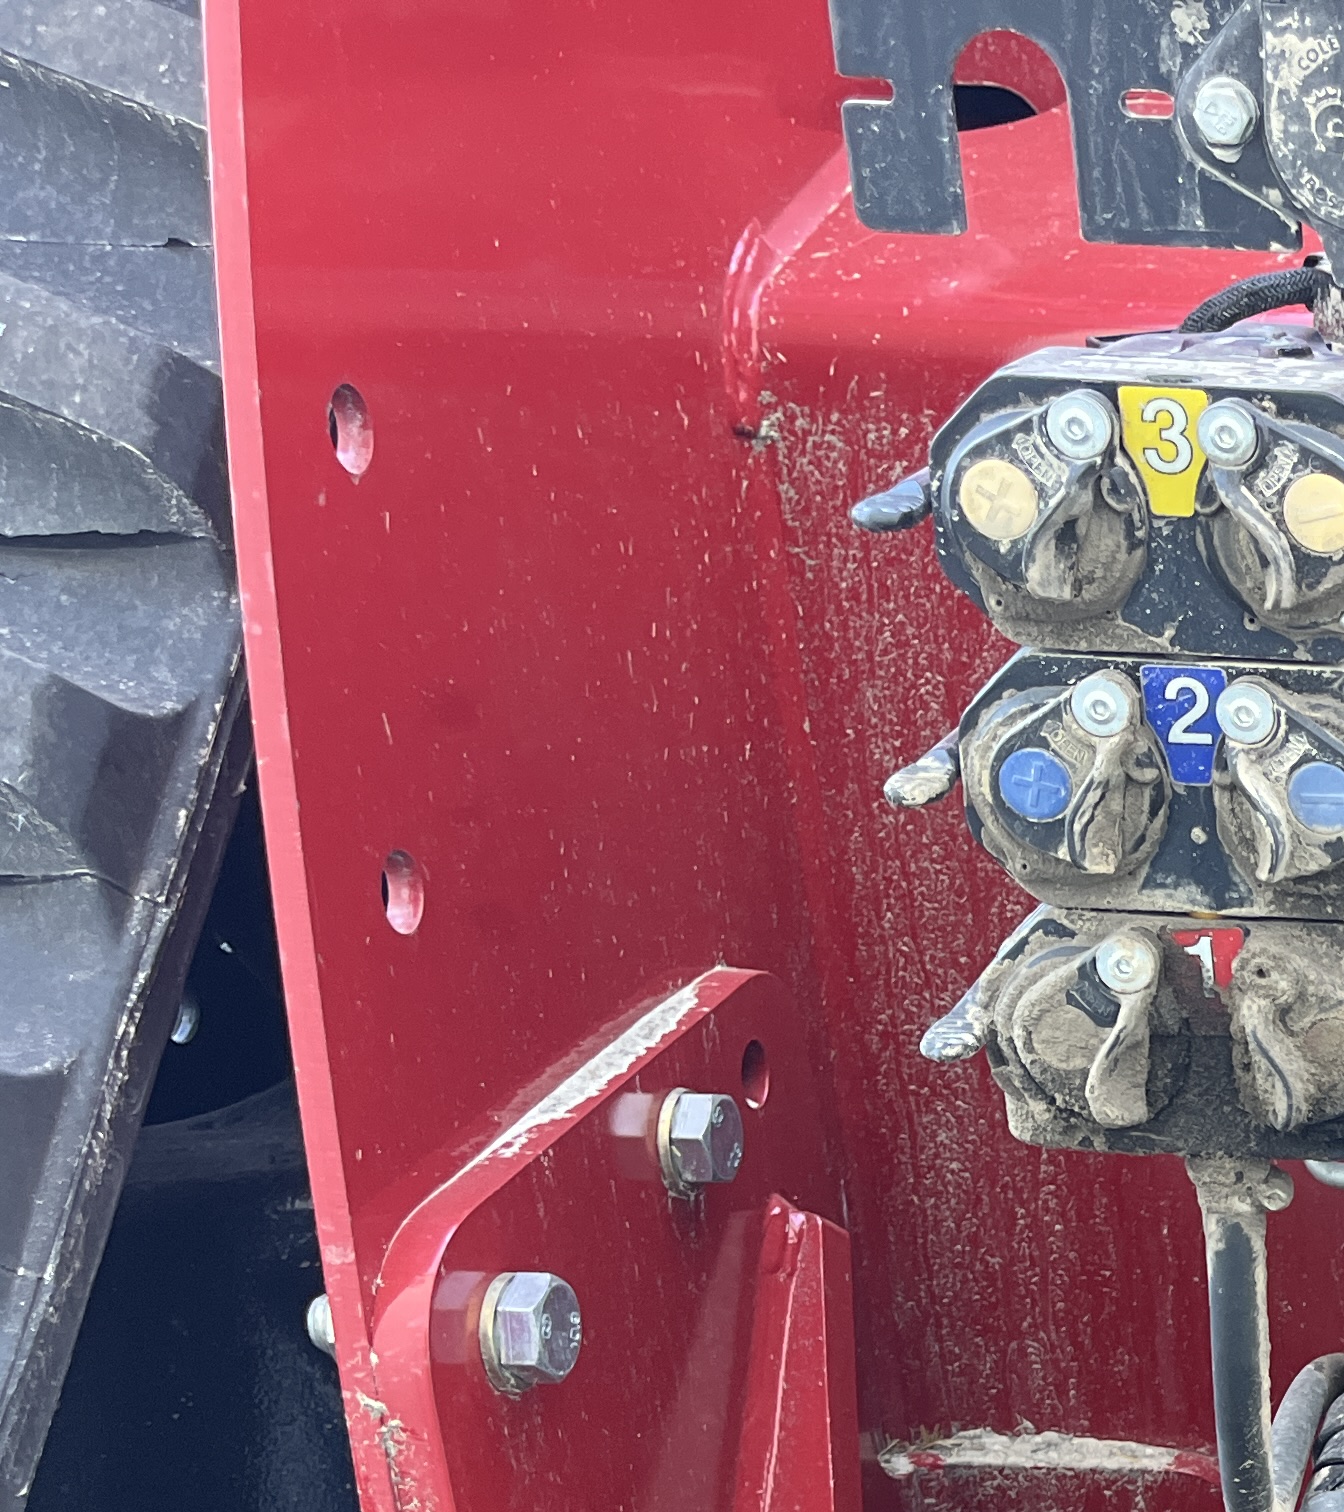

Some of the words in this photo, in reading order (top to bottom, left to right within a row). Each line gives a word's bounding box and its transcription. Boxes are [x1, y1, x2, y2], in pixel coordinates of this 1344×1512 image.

[1297, 35, 1340, 71] COLE
[1141, 397, 1193, 475] 3
[1261, 448, 1296, 494] OPEN
[1164, 677, 1213, 745] 2
[1184, 936, 1215, 998] 1
